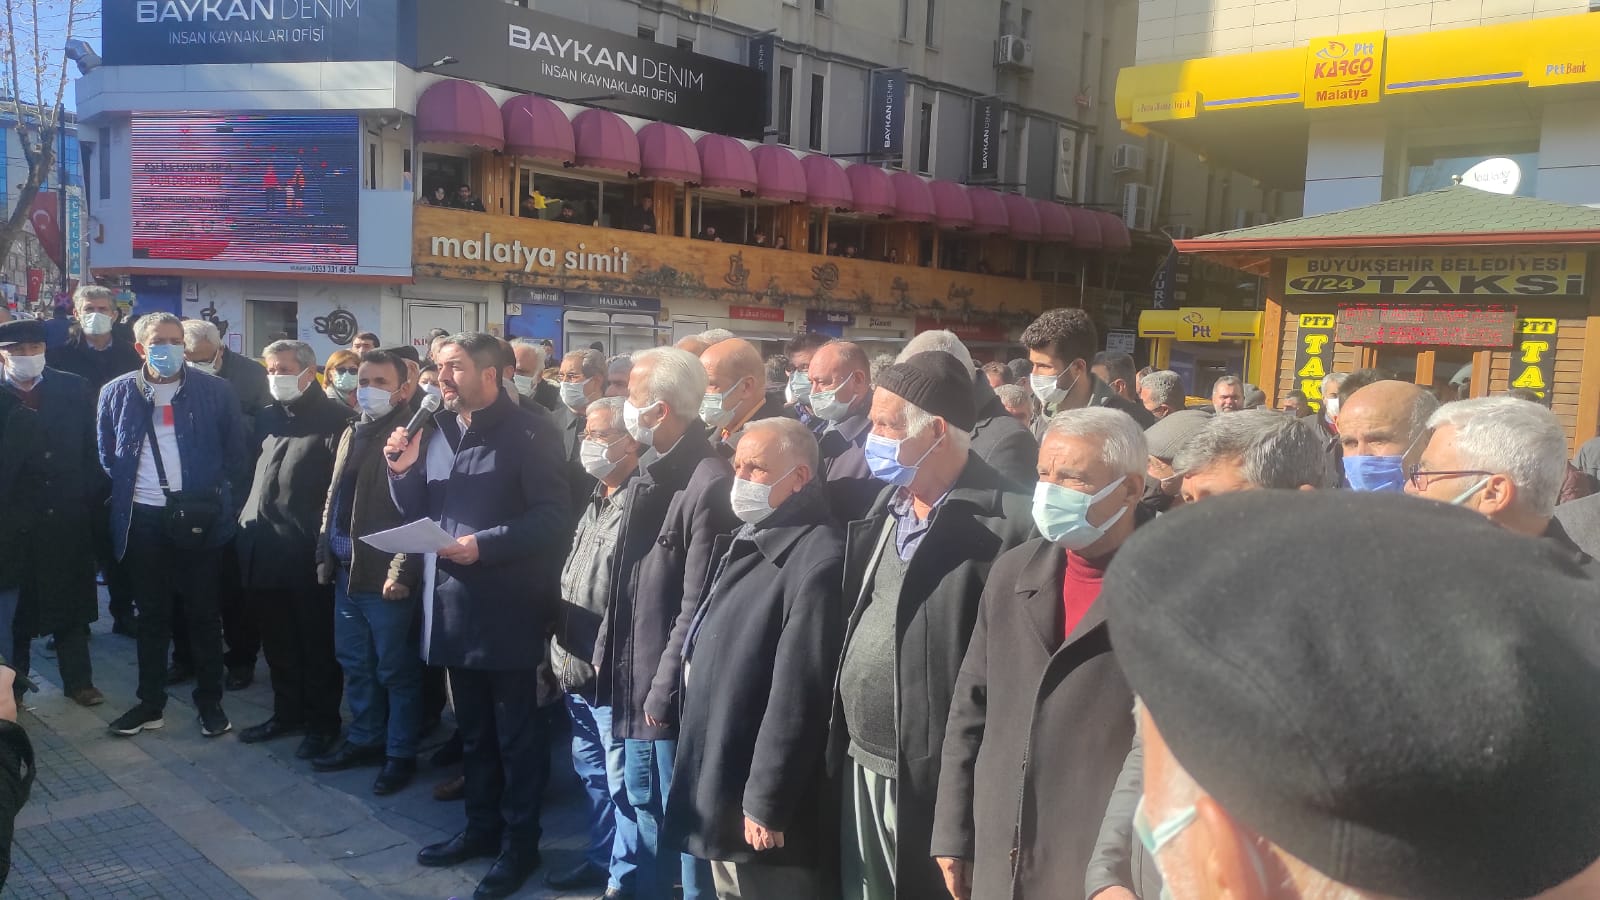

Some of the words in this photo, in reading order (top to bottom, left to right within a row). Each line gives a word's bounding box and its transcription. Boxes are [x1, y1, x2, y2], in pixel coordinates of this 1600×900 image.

[136, 0, 274, 22] BAYKAN
[281, 0, 361, 20] DENIM
[209, 29, 288, 43] KAYNAKLARI
[508, 23, 638, 75] BAYKAN
[642, 57, 704, 92] DENIM
[1353, 43, 1374, 56] Ptt
[1313, 57, 1374, 80] KARGO
[541, 60, 578, 82] İNSAN
[580, 71, 649, 98] KAYNAKLARI
[1315, 88, 1369, 102] Malatya
[884, 105, 893, 148] BAYKAN
[431, 232, 556, 272] malatya
[564, 242, 630, 274] simit
[1307, 256, 1434, 274] BÜYÜKŞEHİR
[1441, 254, 1567, 272] BELEDİYESİ
[1300, 278, 1356, 290] 7/24
[599, 296, 638, 307] HALKBANK
[1192, 324, 1211, 338] Ptt
[1302, 316, 1331, 326] PTT
[1298, 333, 1329, 414] TAK
